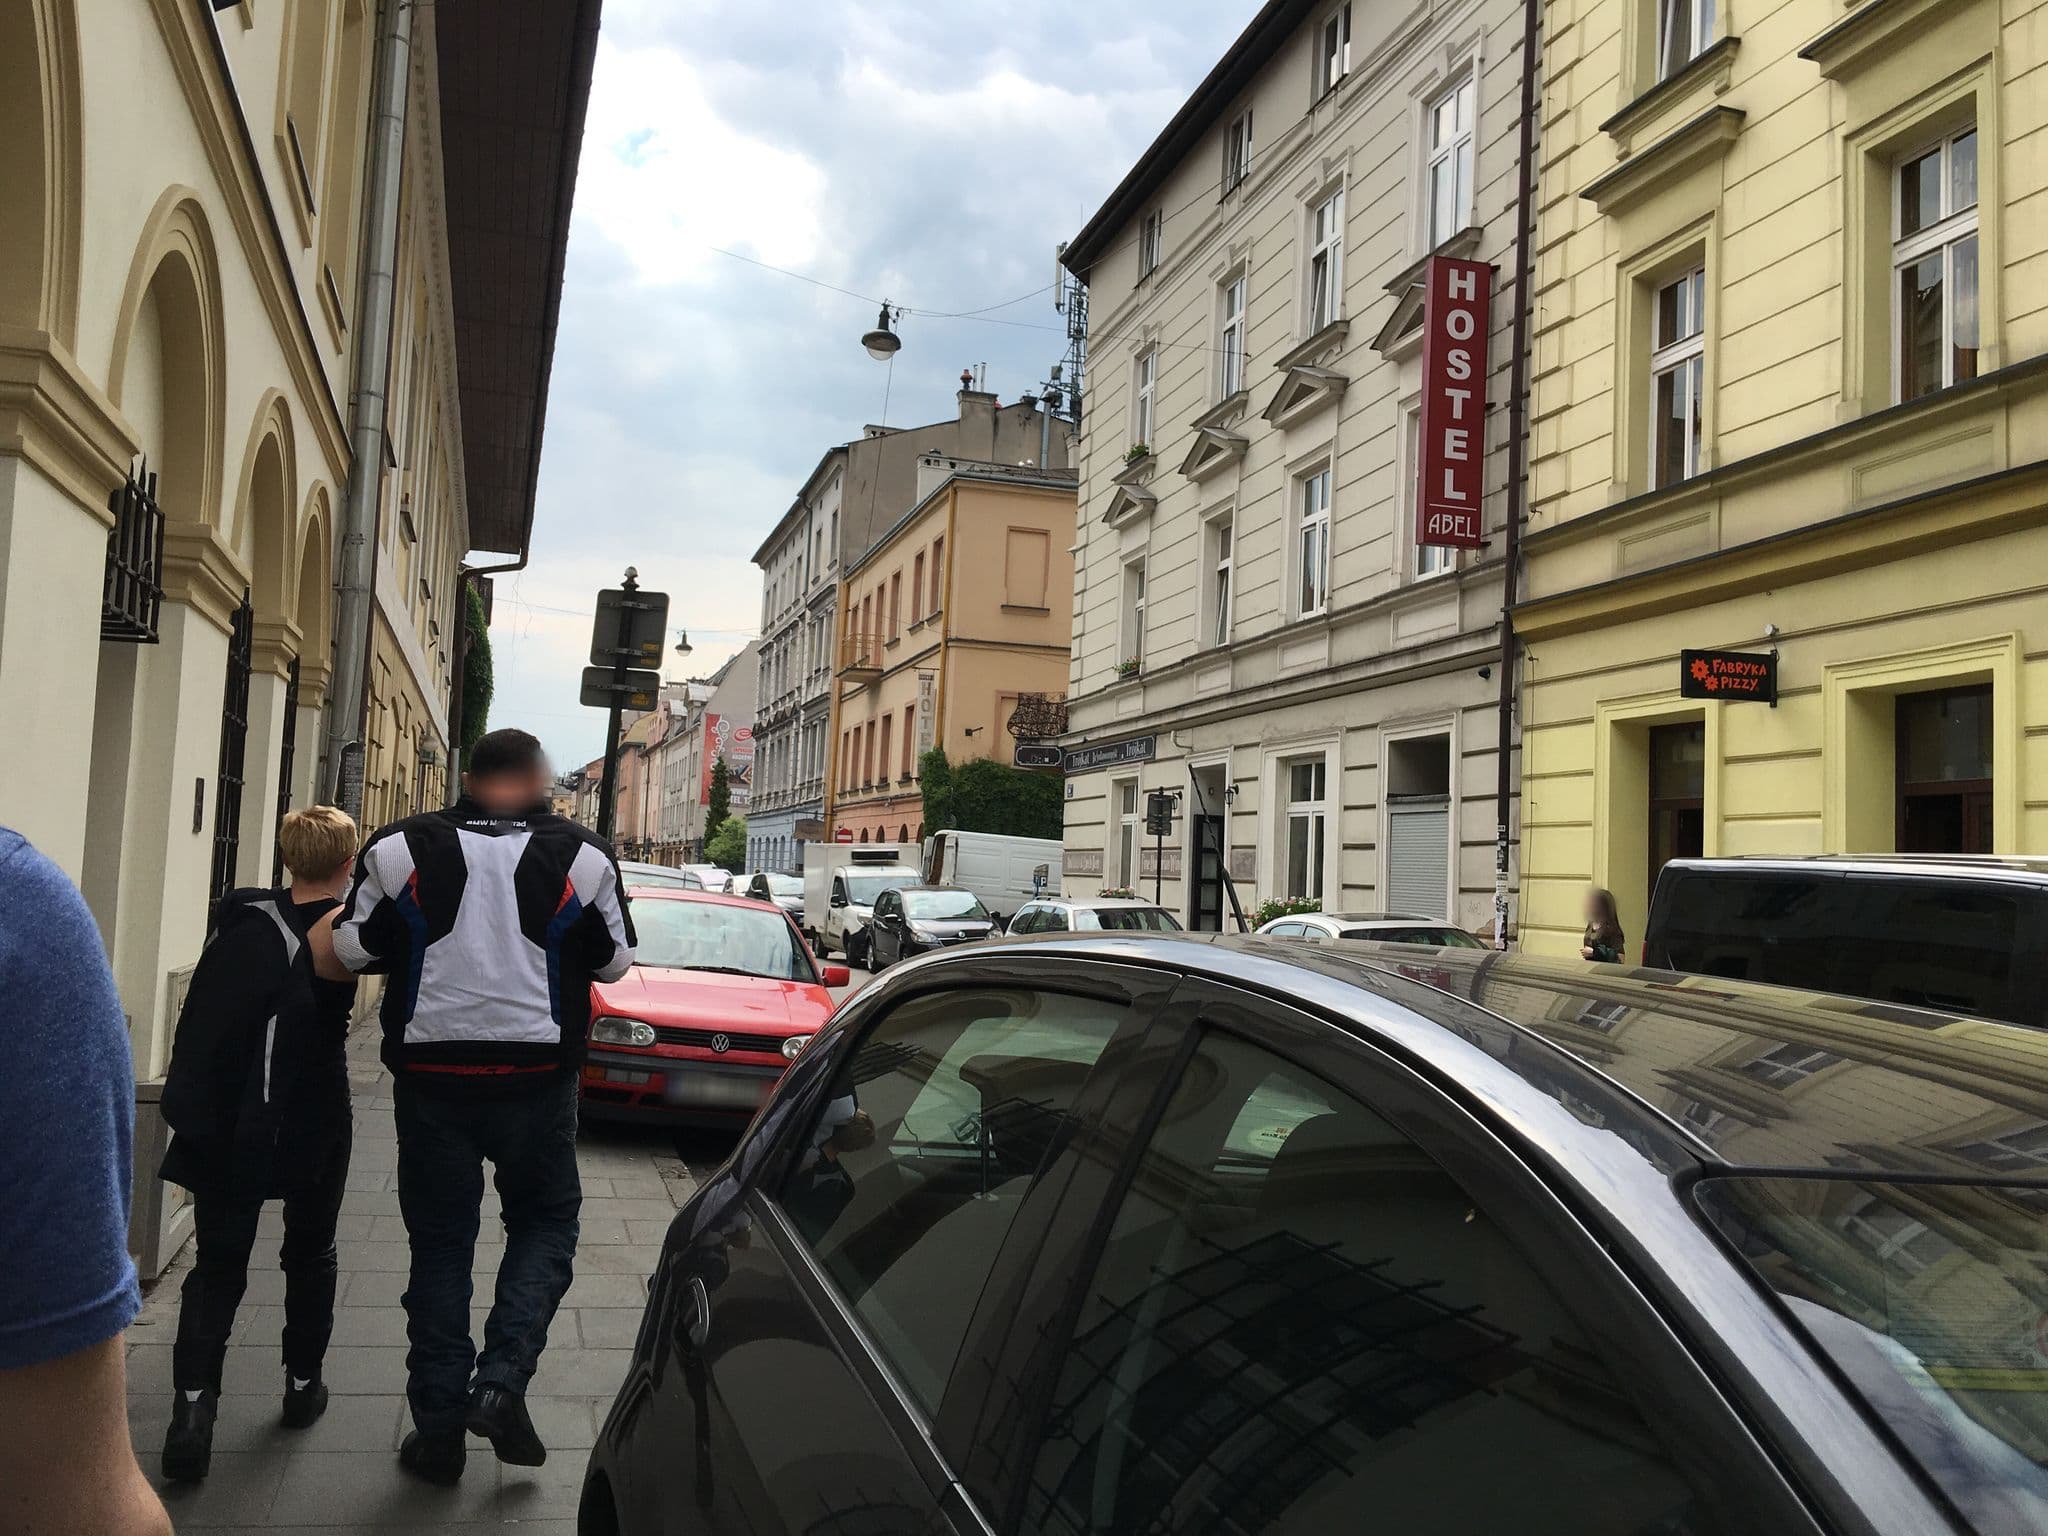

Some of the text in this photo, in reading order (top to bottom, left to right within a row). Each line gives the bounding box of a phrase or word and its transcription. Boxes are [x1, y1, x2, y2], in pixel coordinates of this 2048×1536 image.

[1443, 268, 1477, 501] HOSTEL
[1428, 513, 1477, 538] ABEL
[1712, 658, 1767, 676] FABRYKA
[1721, 676, 1759, 691] PIZZY
[921, 681, 932, 753] HOTE
